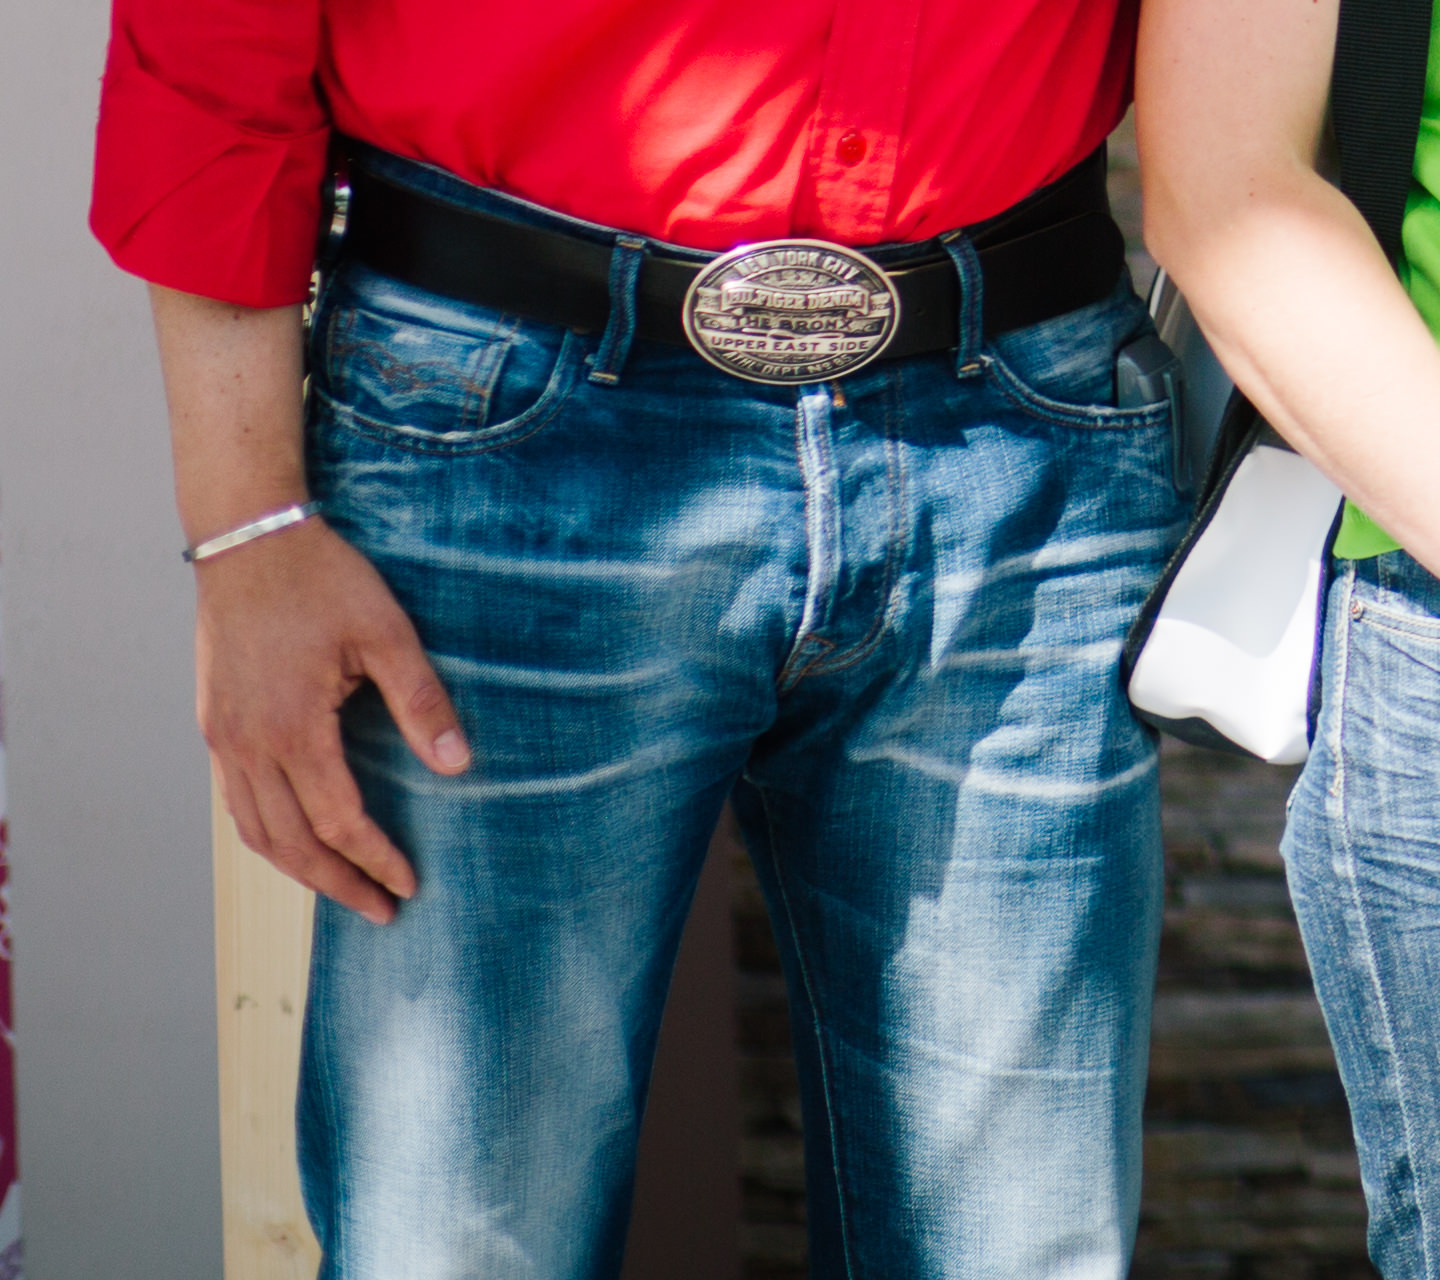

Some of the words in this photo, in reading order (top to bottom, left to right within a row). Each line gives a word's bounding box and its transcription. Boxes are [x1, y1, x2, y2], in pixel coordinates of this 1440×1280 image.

[711, 335, 766, 350] UPPER
[773, 340, 820, 352] EAST
[829, 340, 869, 352] SIDE
